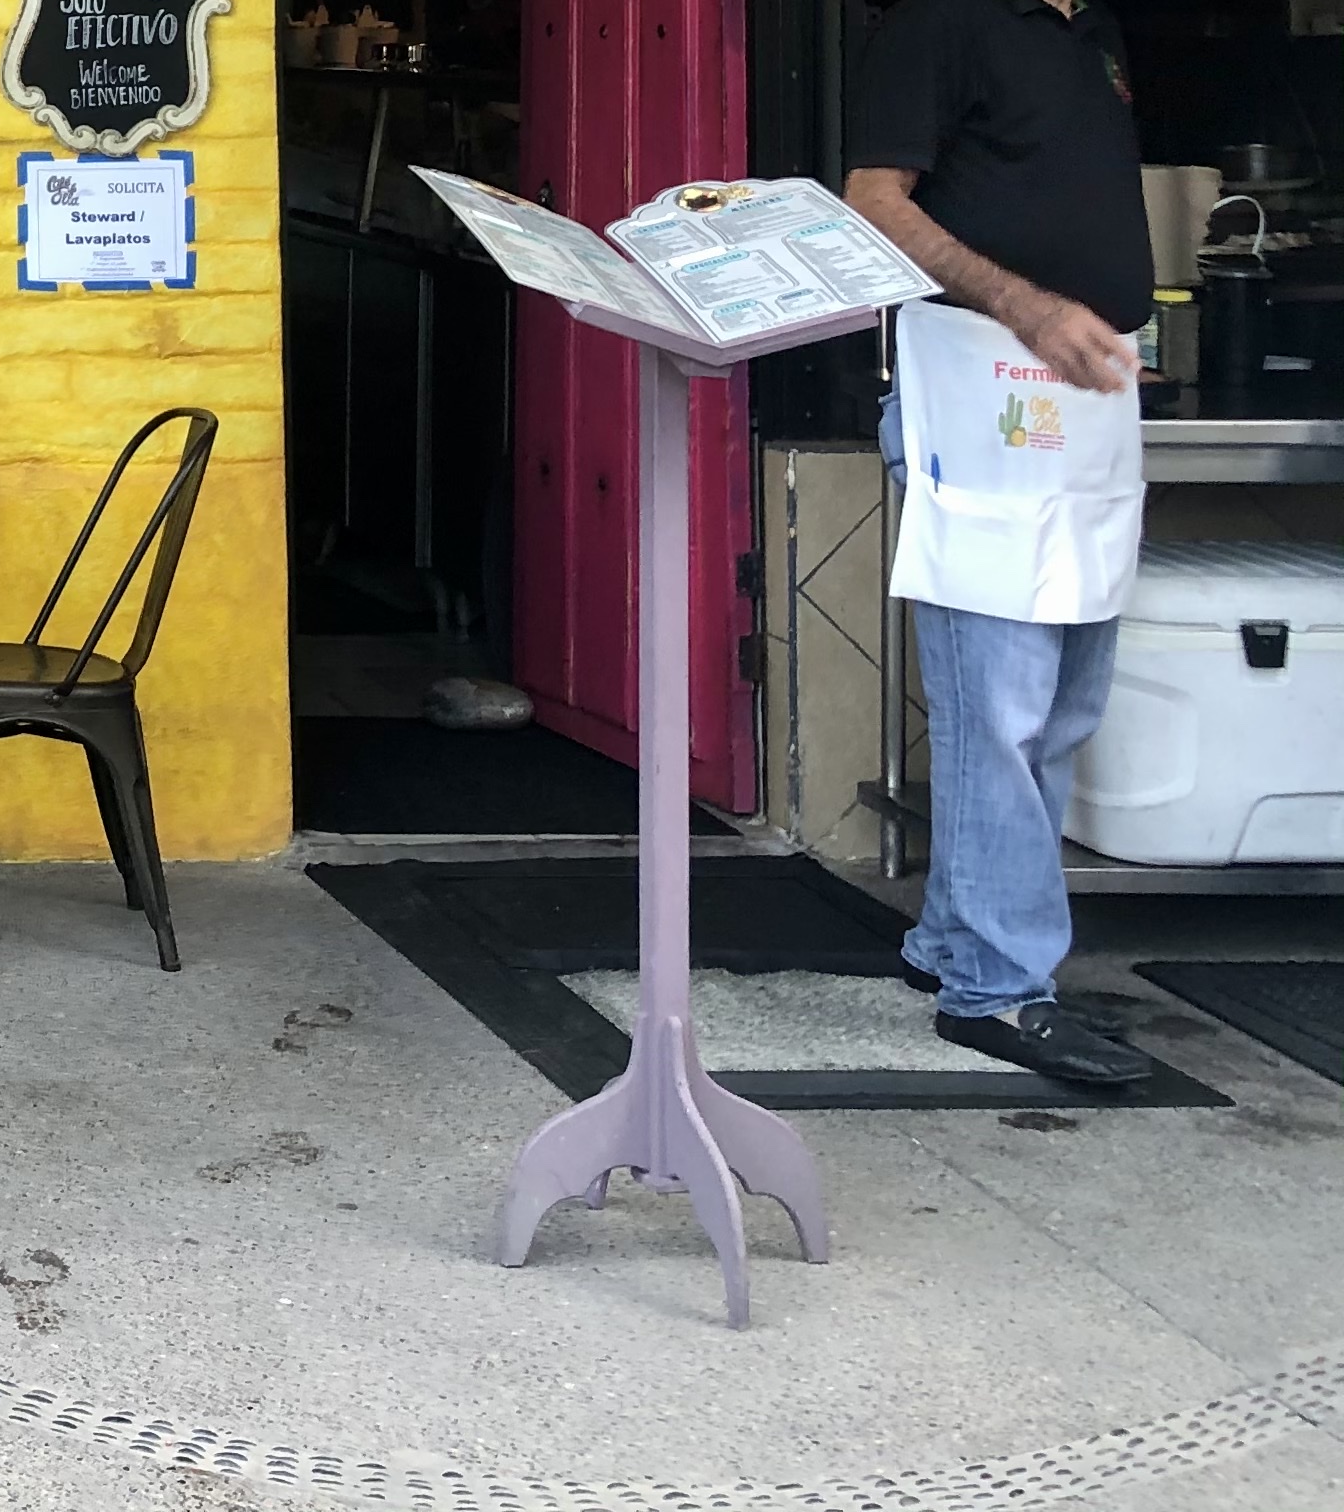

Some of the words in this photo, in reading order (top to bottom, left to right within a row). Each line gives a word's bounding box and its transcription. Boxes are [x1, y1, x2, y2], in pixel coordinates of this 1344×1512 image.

[65, 9, 178, 49] EFECTIVO
[70, 85, 161, 109] BIENVENIDO
[107, 181, 165, 194] SOLICITA
[70, 211, 136, 223] Steward
[65, 233, 151, 247] Lavaplatos
[994, 361, 1065, 384] Fermi
